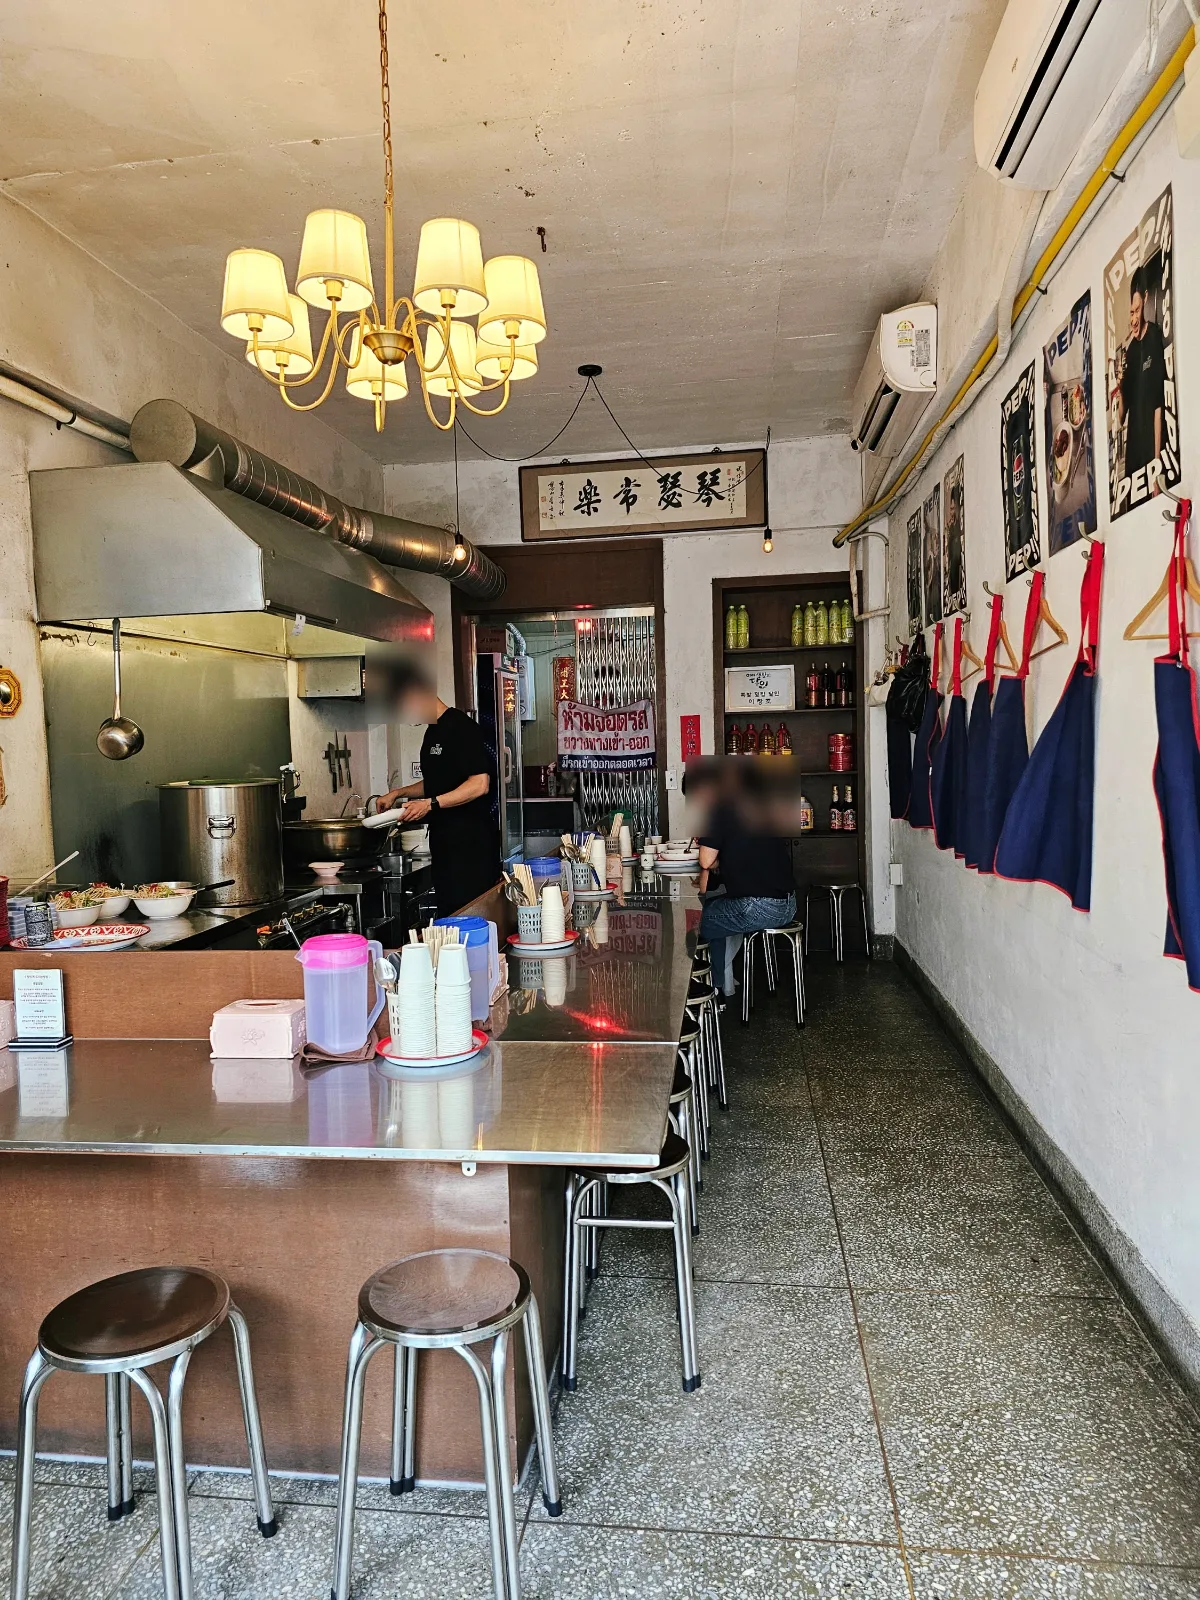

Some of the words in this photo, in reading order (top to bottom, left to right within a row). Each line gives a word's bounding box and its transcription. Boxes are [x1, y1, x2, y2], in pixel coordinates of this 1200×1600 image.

[1109, 194, 1167, 292] PEP!
[1003, 364, 1033, 421] PEP!
[1115, 449, 1175, 514] PEP!
[562, 702, 649, 732] ห้ามจอดรถ
[563, 732, 650, 751] ขวางทางเข้า-ออก
